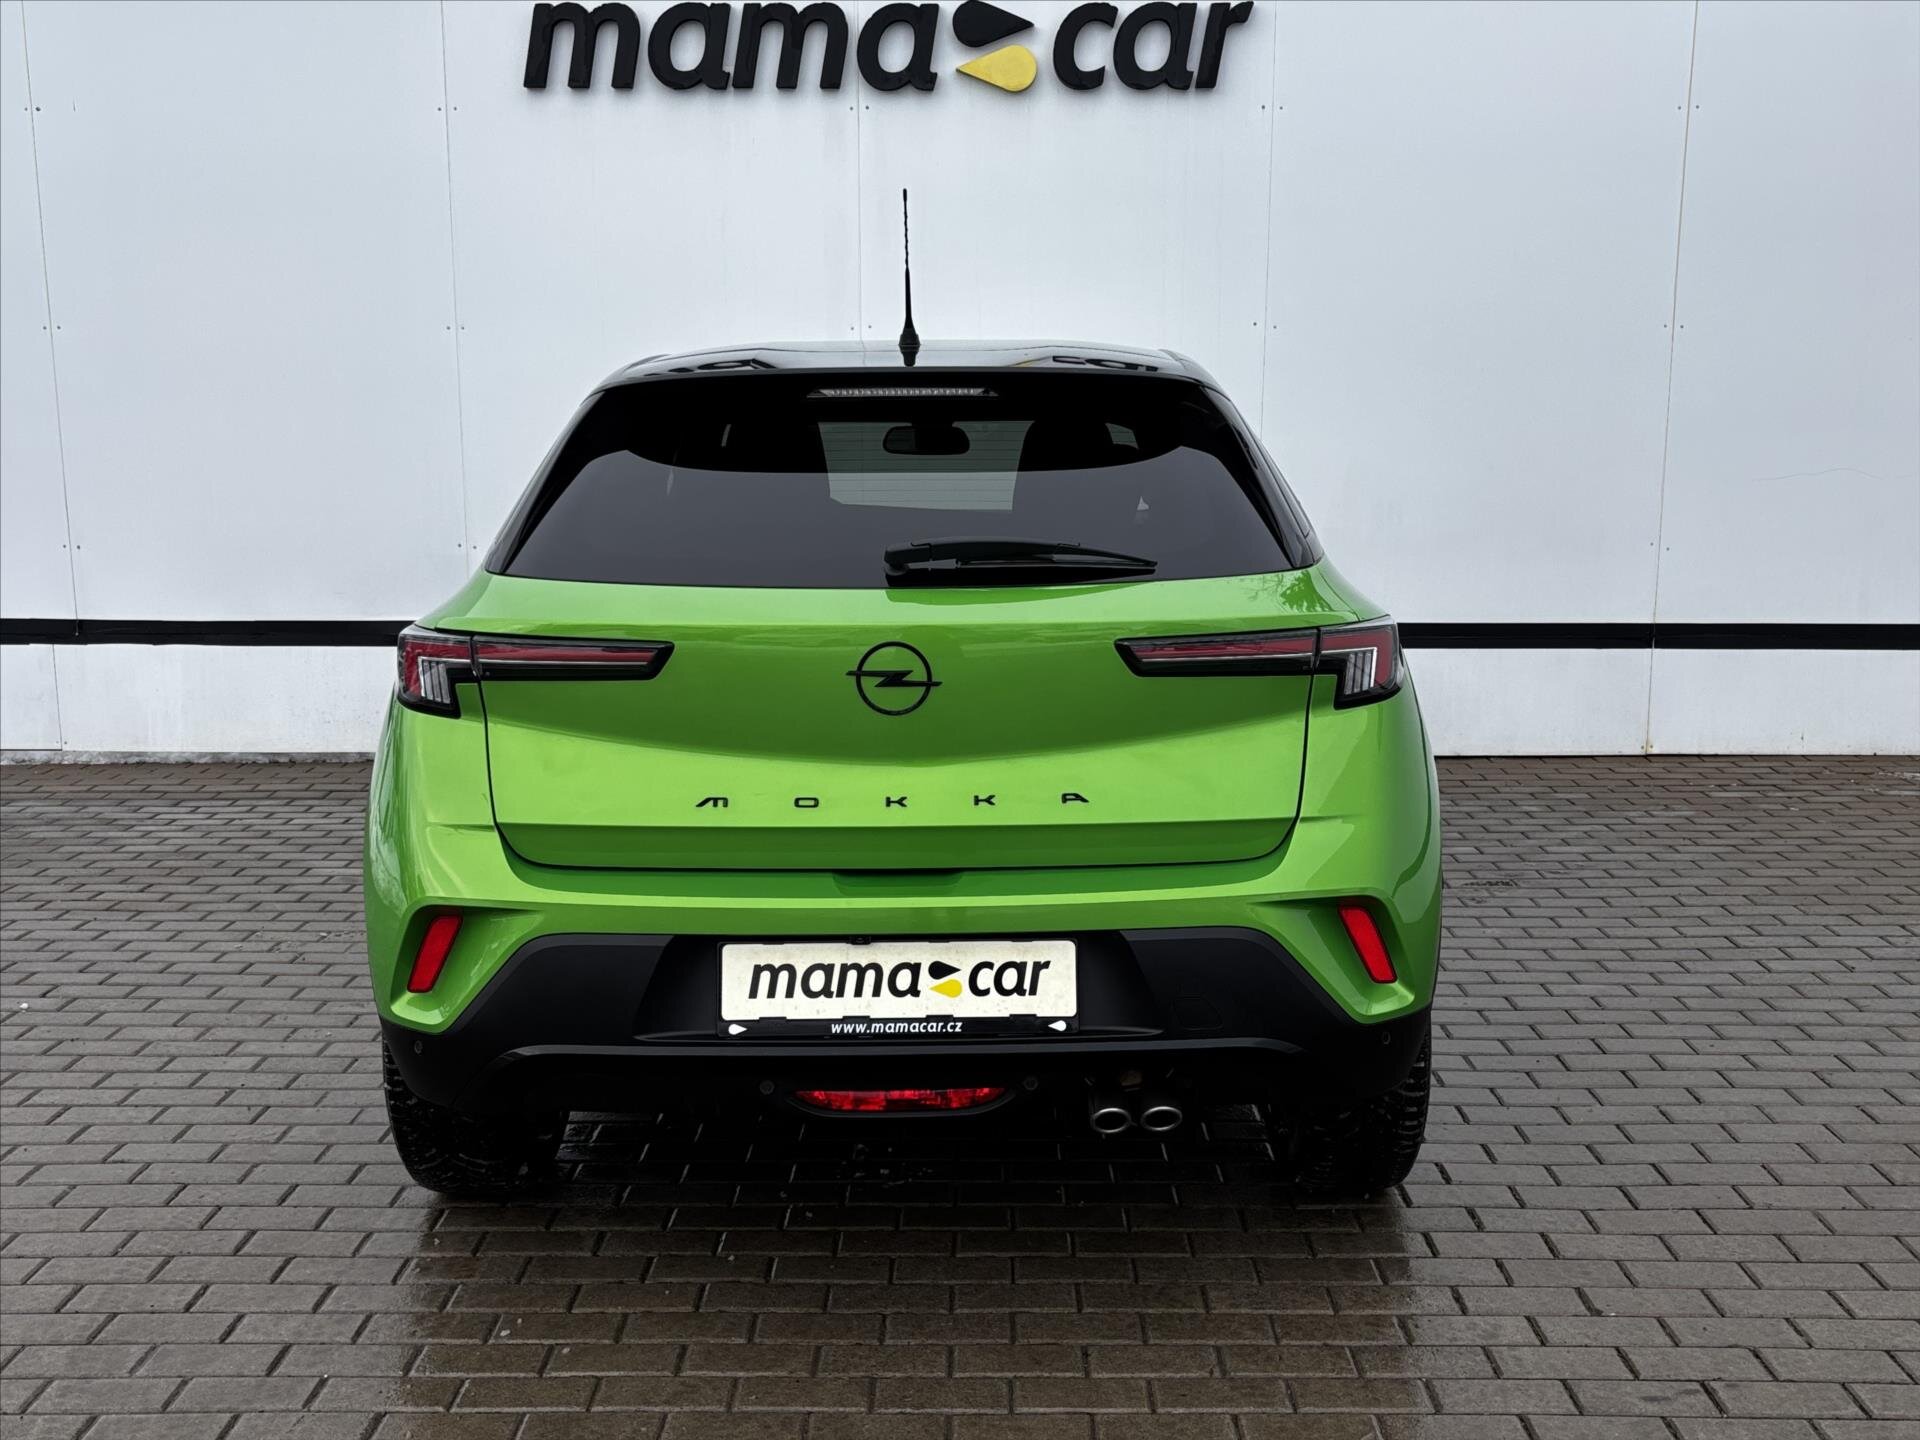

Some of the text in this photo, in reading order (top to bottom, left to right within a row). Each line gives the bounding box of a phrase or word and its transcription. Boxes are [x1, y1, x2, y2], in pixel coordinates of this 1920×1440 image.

[523, 0, 1255, 92] mama car
[695, 792, 1089, 808] MOKKA
[748, 960, 1051, 999] mama car
[831, 1020, 963, 1034] www.mamacar.cz
